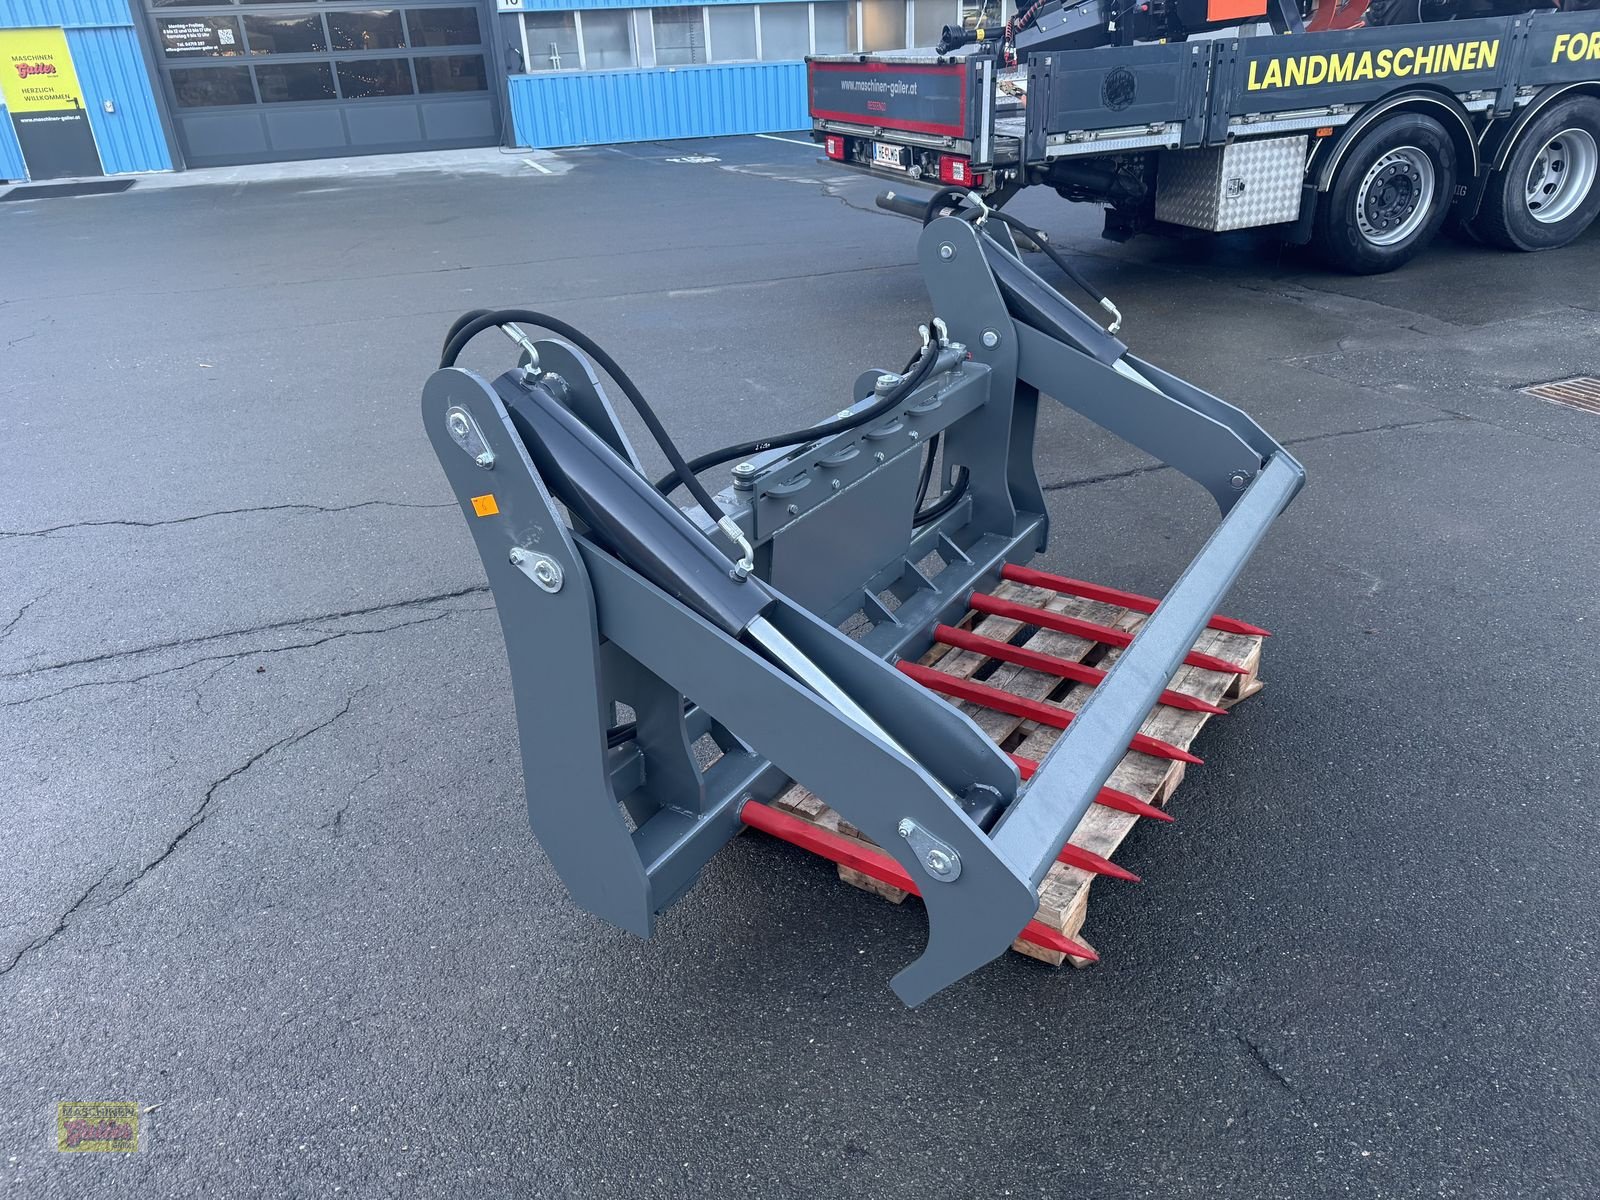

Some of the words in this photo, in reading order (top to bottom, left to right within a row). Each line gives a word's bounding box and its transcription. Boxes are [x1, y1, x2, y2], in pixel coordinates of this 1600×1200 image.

[1551, 31, 1600, 64] FOR
[15, 62, 57, 79] Gailer
[1247, 39, 1500, 91] LANDMASCHINEN
[841, 79, 918, 97] www.maschinen-gailer.at
[24, 94, 71, 102] WILLKOMMEN
[20, 115, 81, 123] www.maschinen-gailer.at
